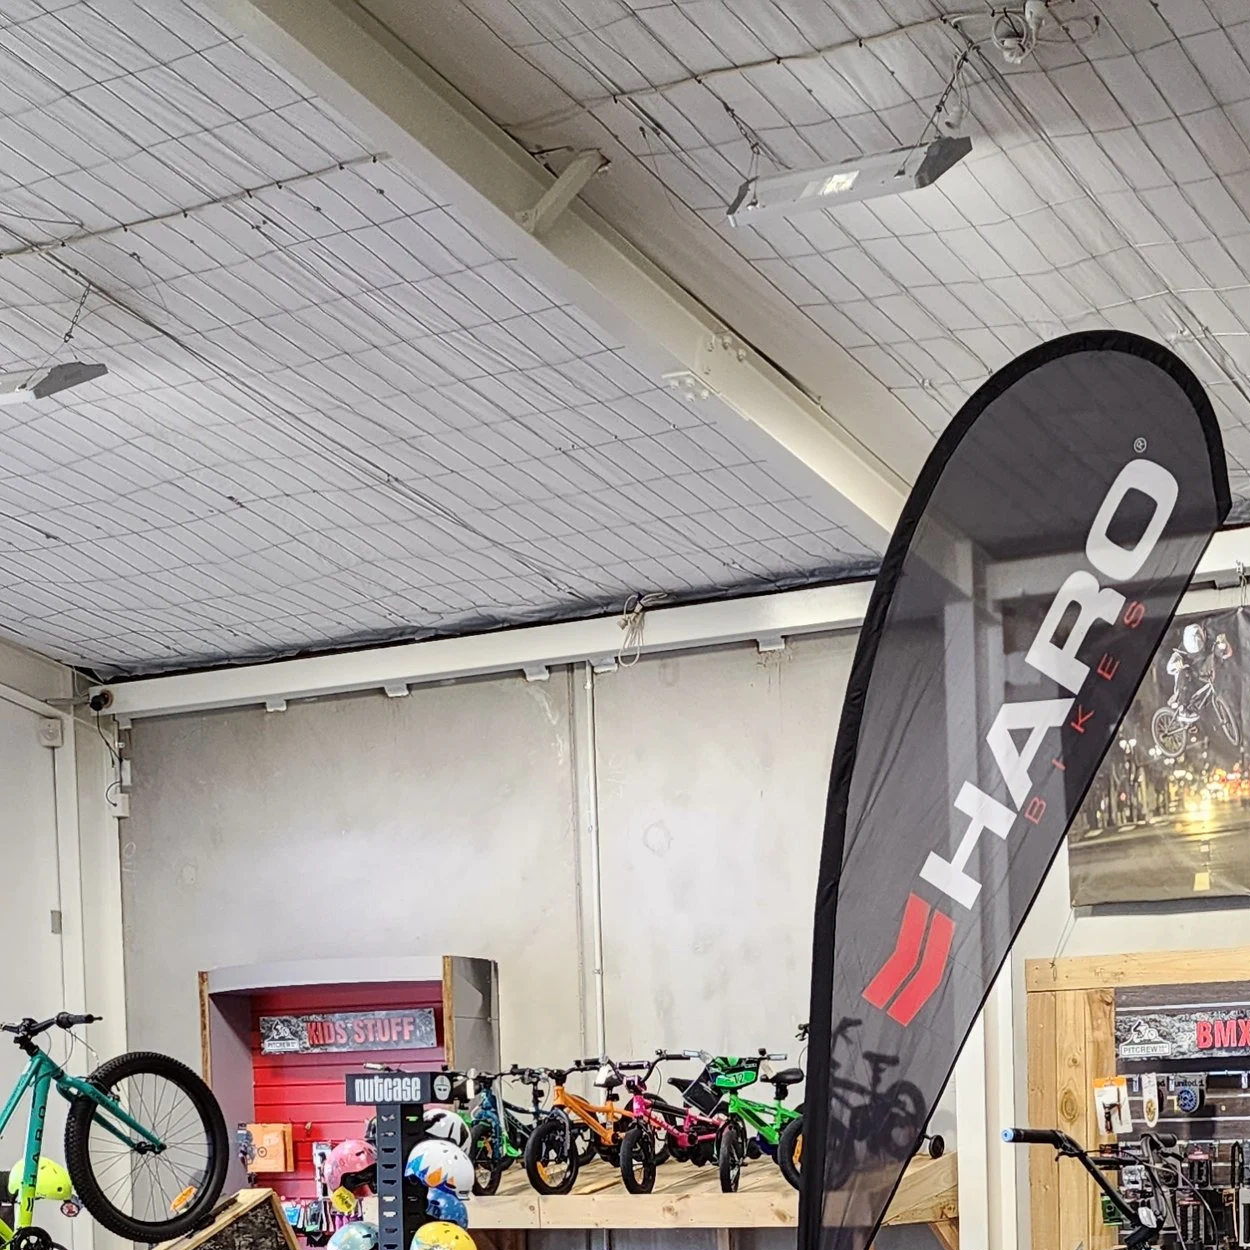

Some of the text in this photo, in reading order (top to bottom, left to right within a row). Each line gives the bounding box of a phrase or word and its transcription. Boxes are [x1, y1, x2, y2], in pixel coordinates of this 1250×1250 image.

[919, 458, 1179, 910] HARO
[1024, 601, 1146, 825] BIKES
[307, 1015, 417, 1046] KIDS STUFF
[1123, 1045, 1158, 1054] PITCREW
[354, 1075, 422, 1102] nutcase
[28, 1105, 46, 1188] HARO
